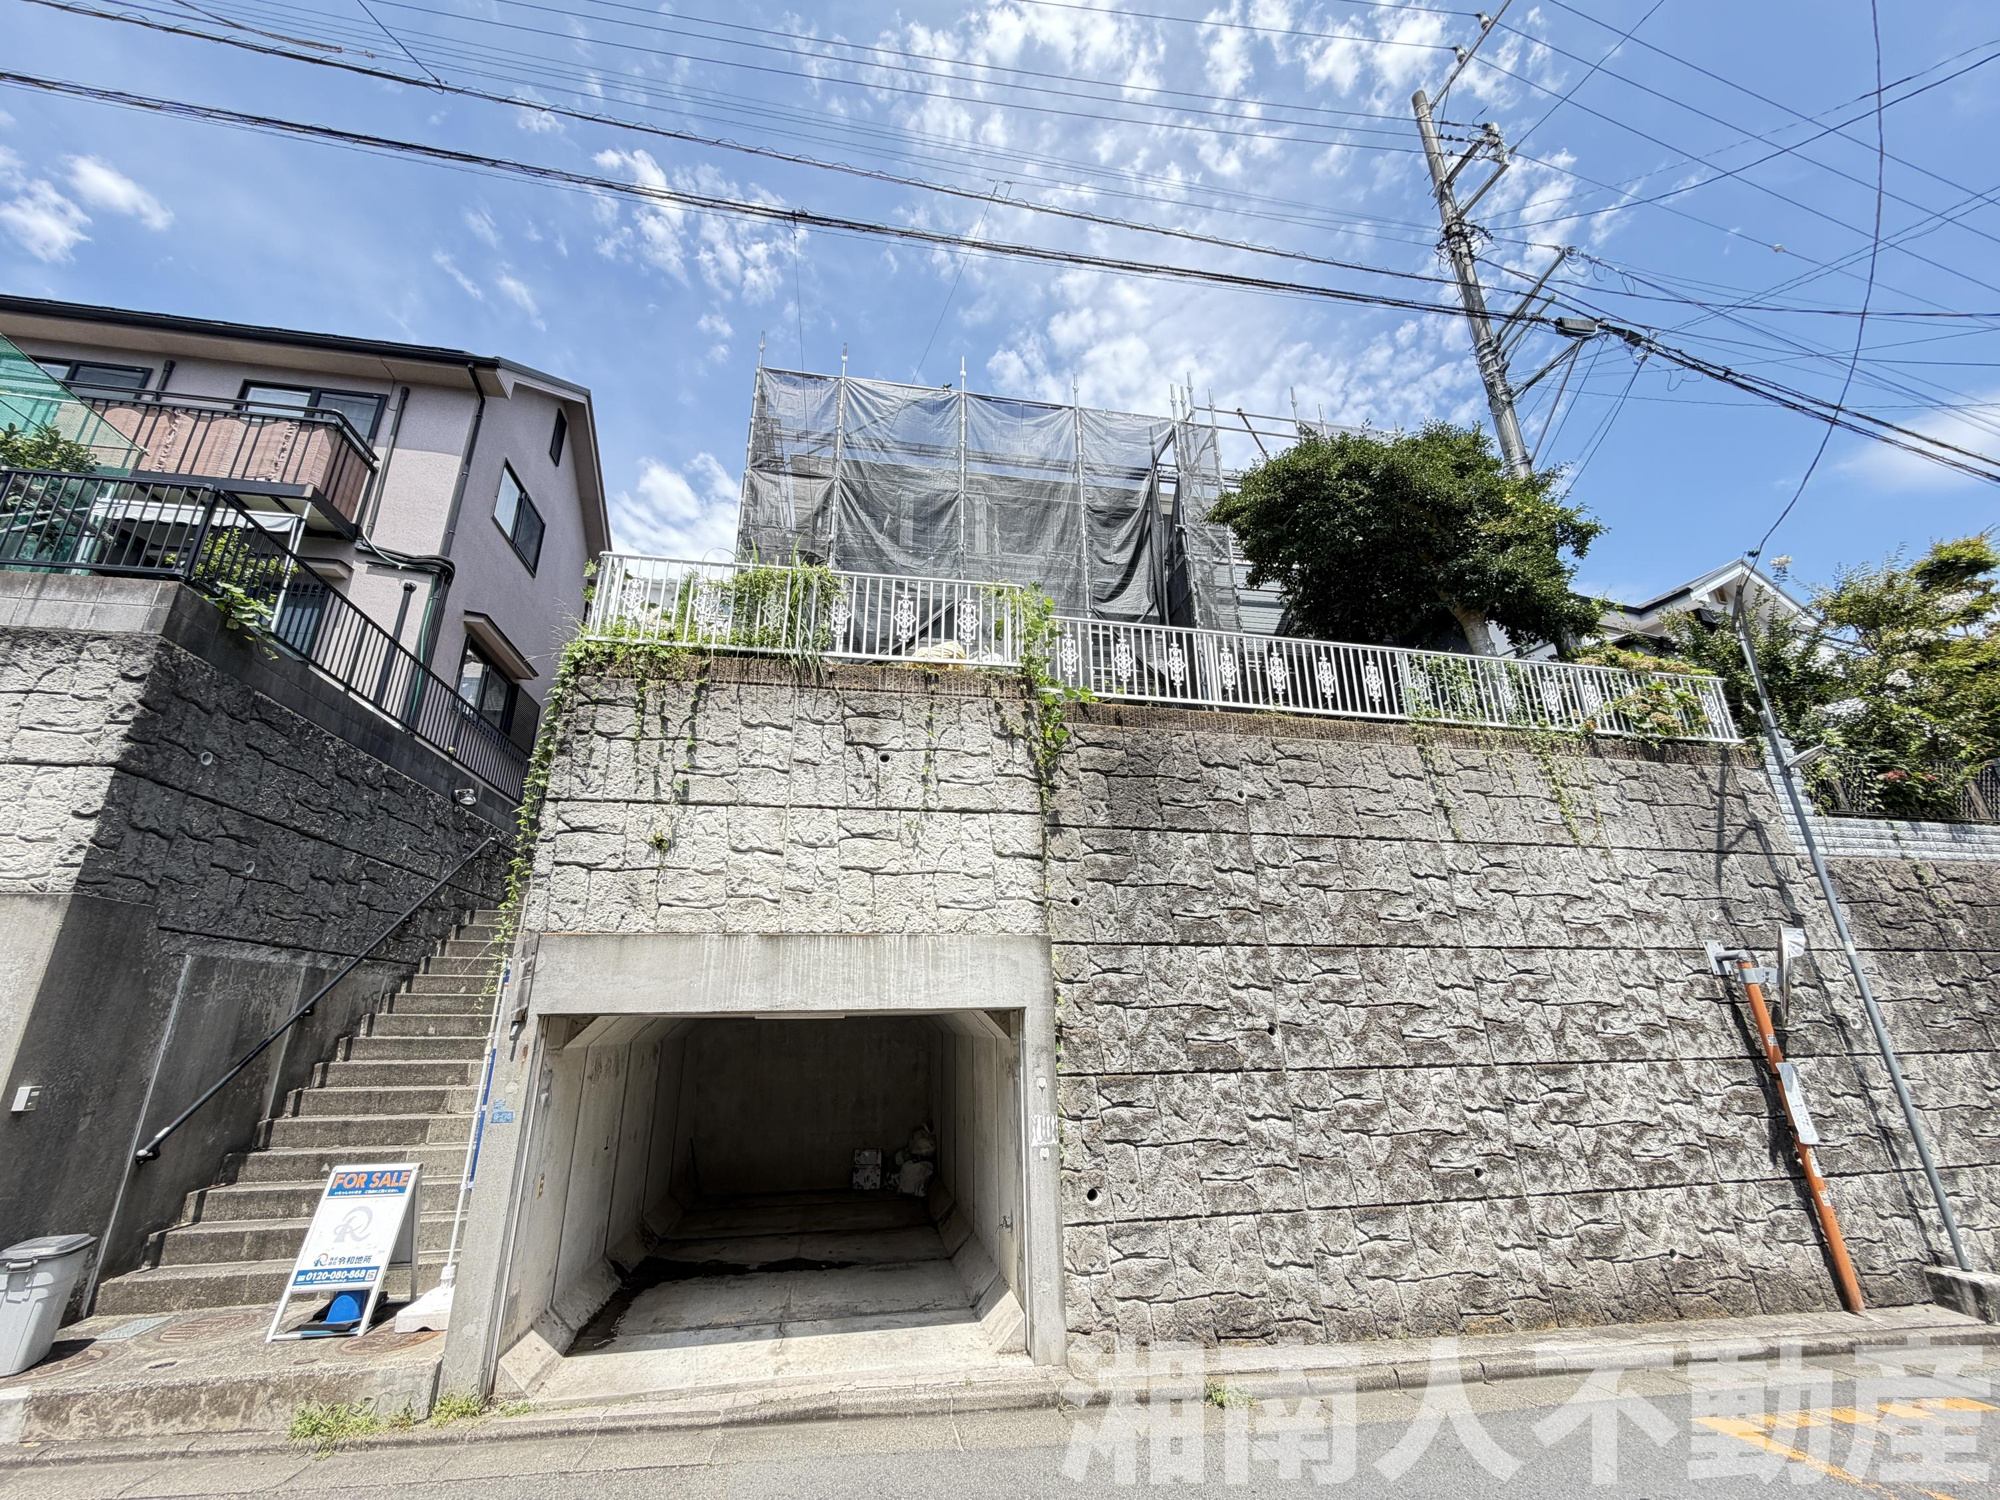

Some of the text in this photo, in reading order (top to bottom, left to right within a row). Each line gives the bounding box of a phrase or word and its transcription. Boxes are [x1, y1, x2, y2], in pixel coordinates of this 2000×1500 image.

[332, 1172, 410, 1189] FOR SALE
[306, 1270, 366, 1281] 0120-080-868
